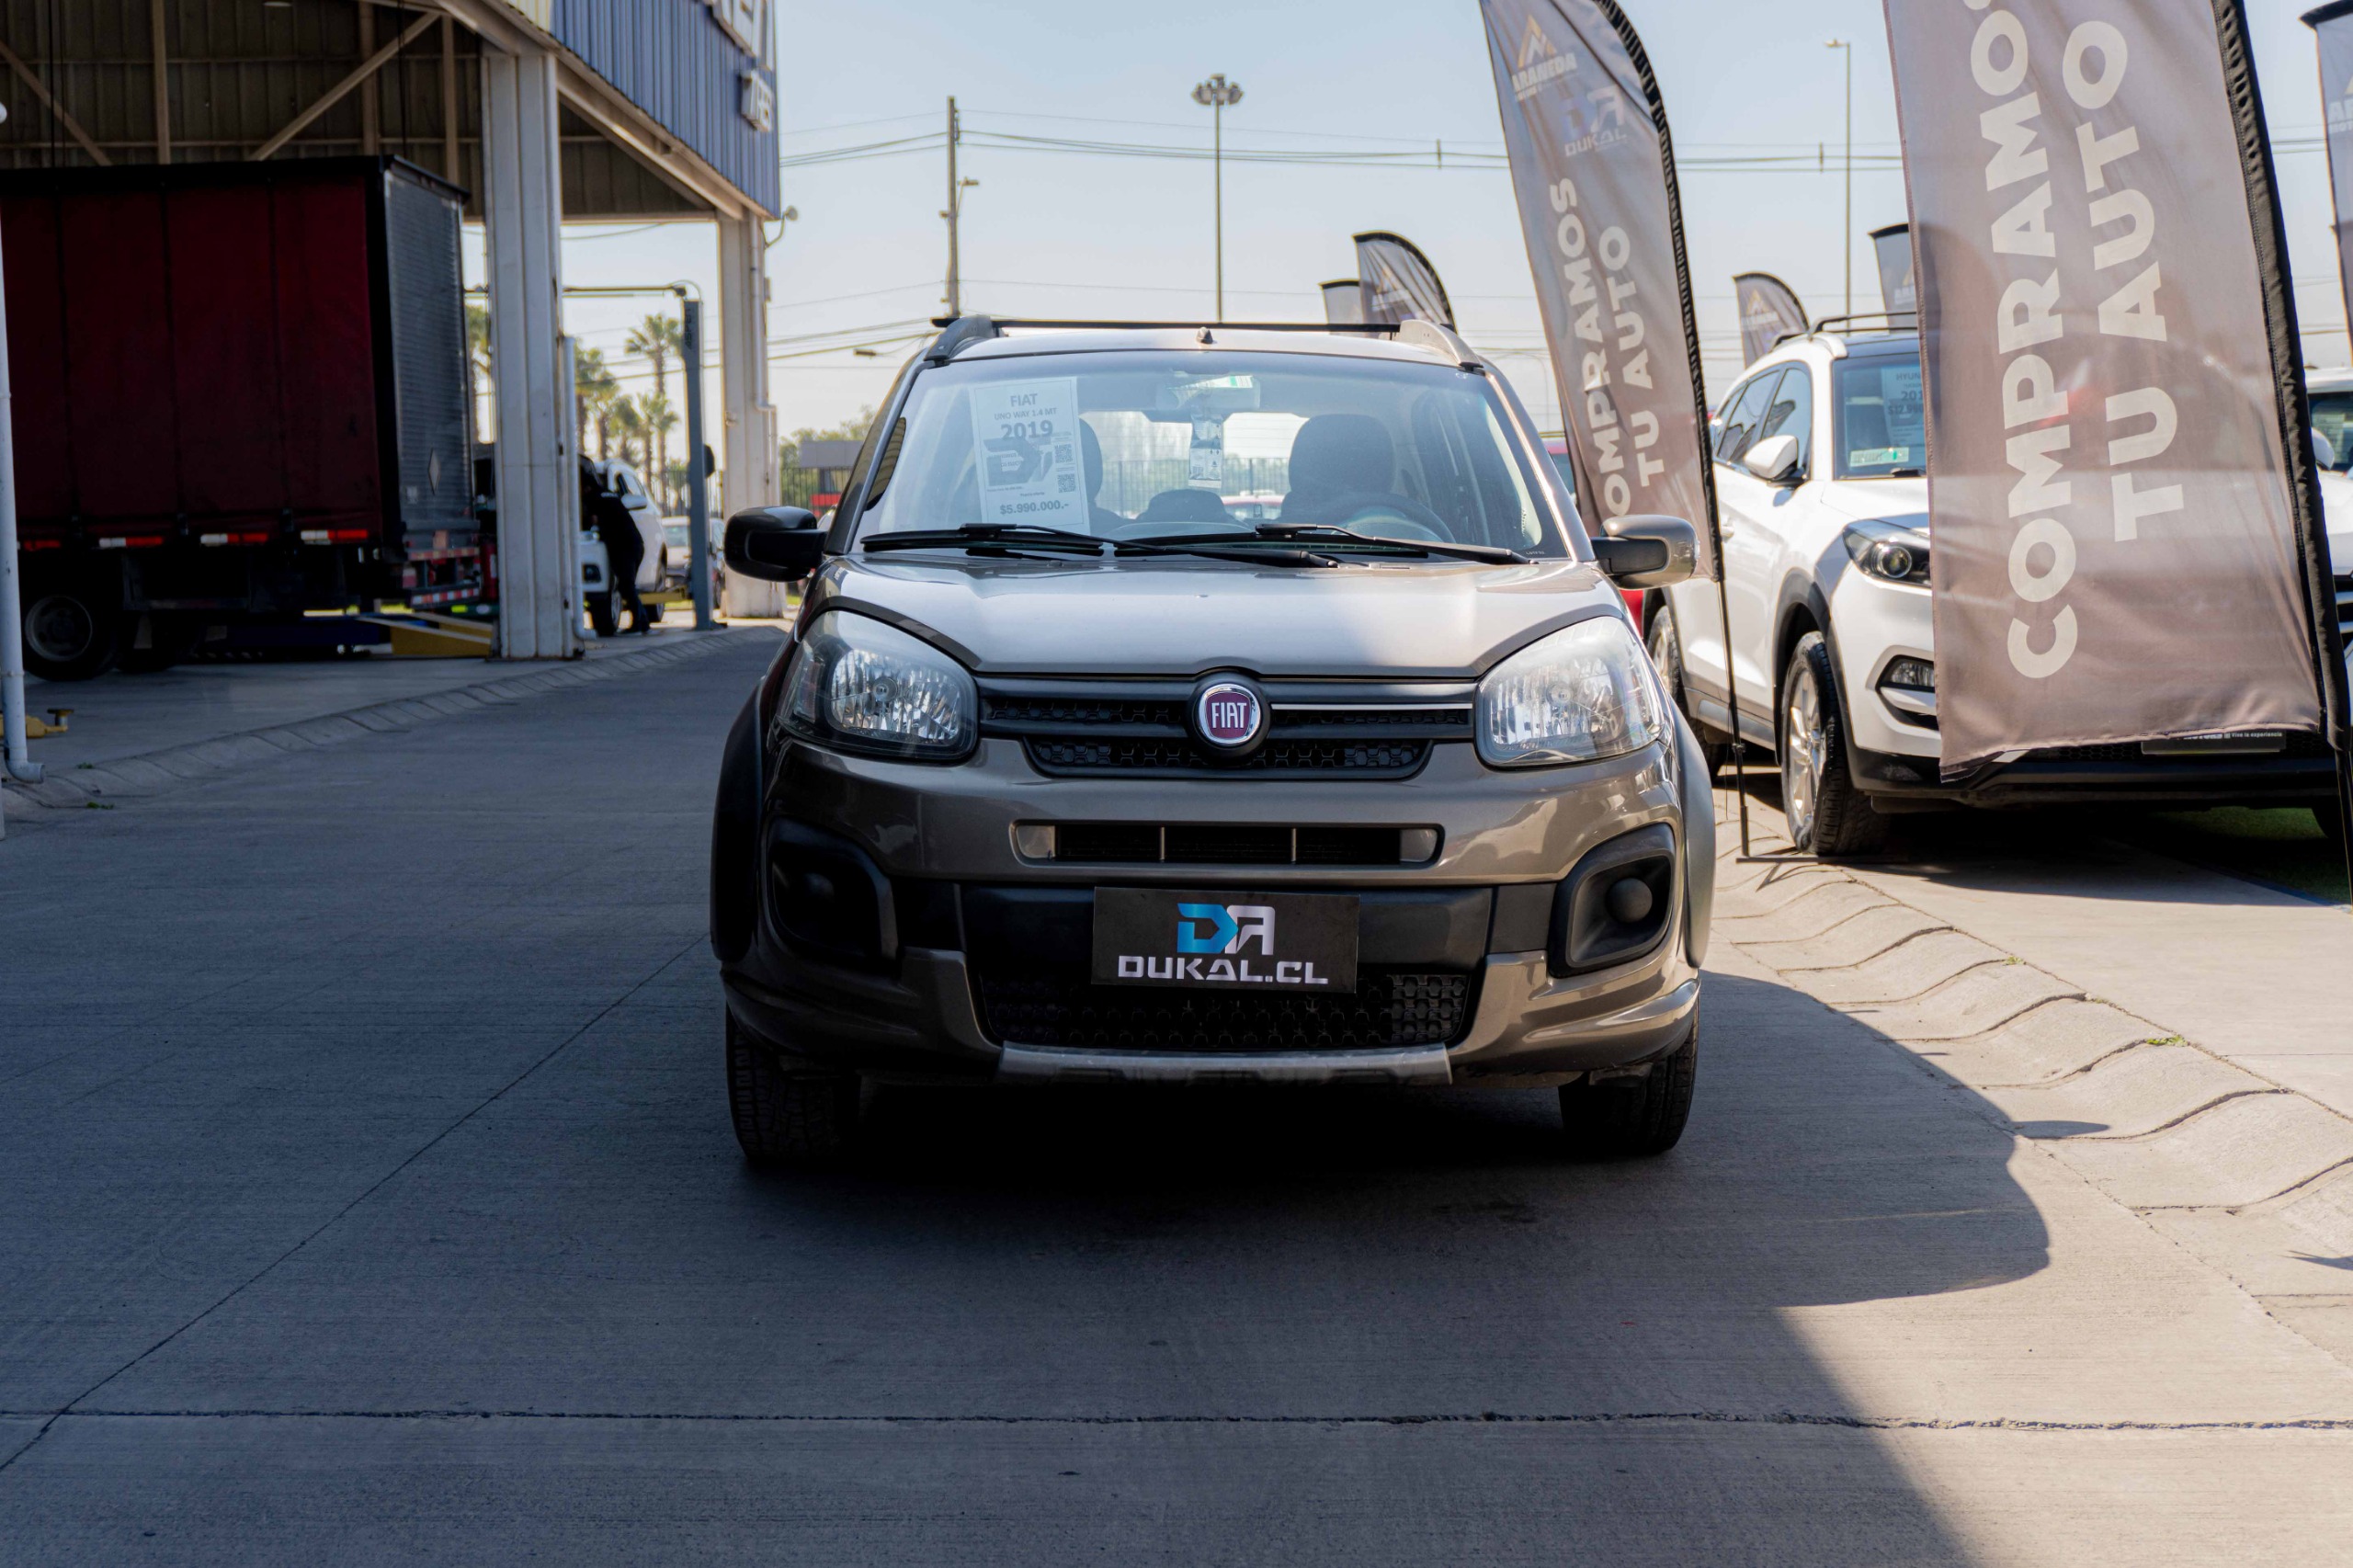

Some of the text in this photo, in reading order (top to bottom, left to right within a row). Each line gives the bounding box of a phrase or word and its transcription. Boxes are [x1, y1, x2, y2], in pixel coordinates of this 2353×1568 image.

[2062, 20, 2184, 542] TU AUTO
[1551, 177, 1631, 516] OMPRAMOS
[1962, 0, 2078, 679] COMPRAMO
[1598, 225, 1665, 487] TU AUTO
[1009, 393, 1039, 407] FIAT
[1901, 390, 1923, 402] 201
[994, 407, 1058, 421] UNO WAY 1.4 MT
[1000, 419, 1053, 441] 2019
[1211, 701, 1247, 729] FIAT
[1118, 955, 1329, 985] DUKAL.CL
